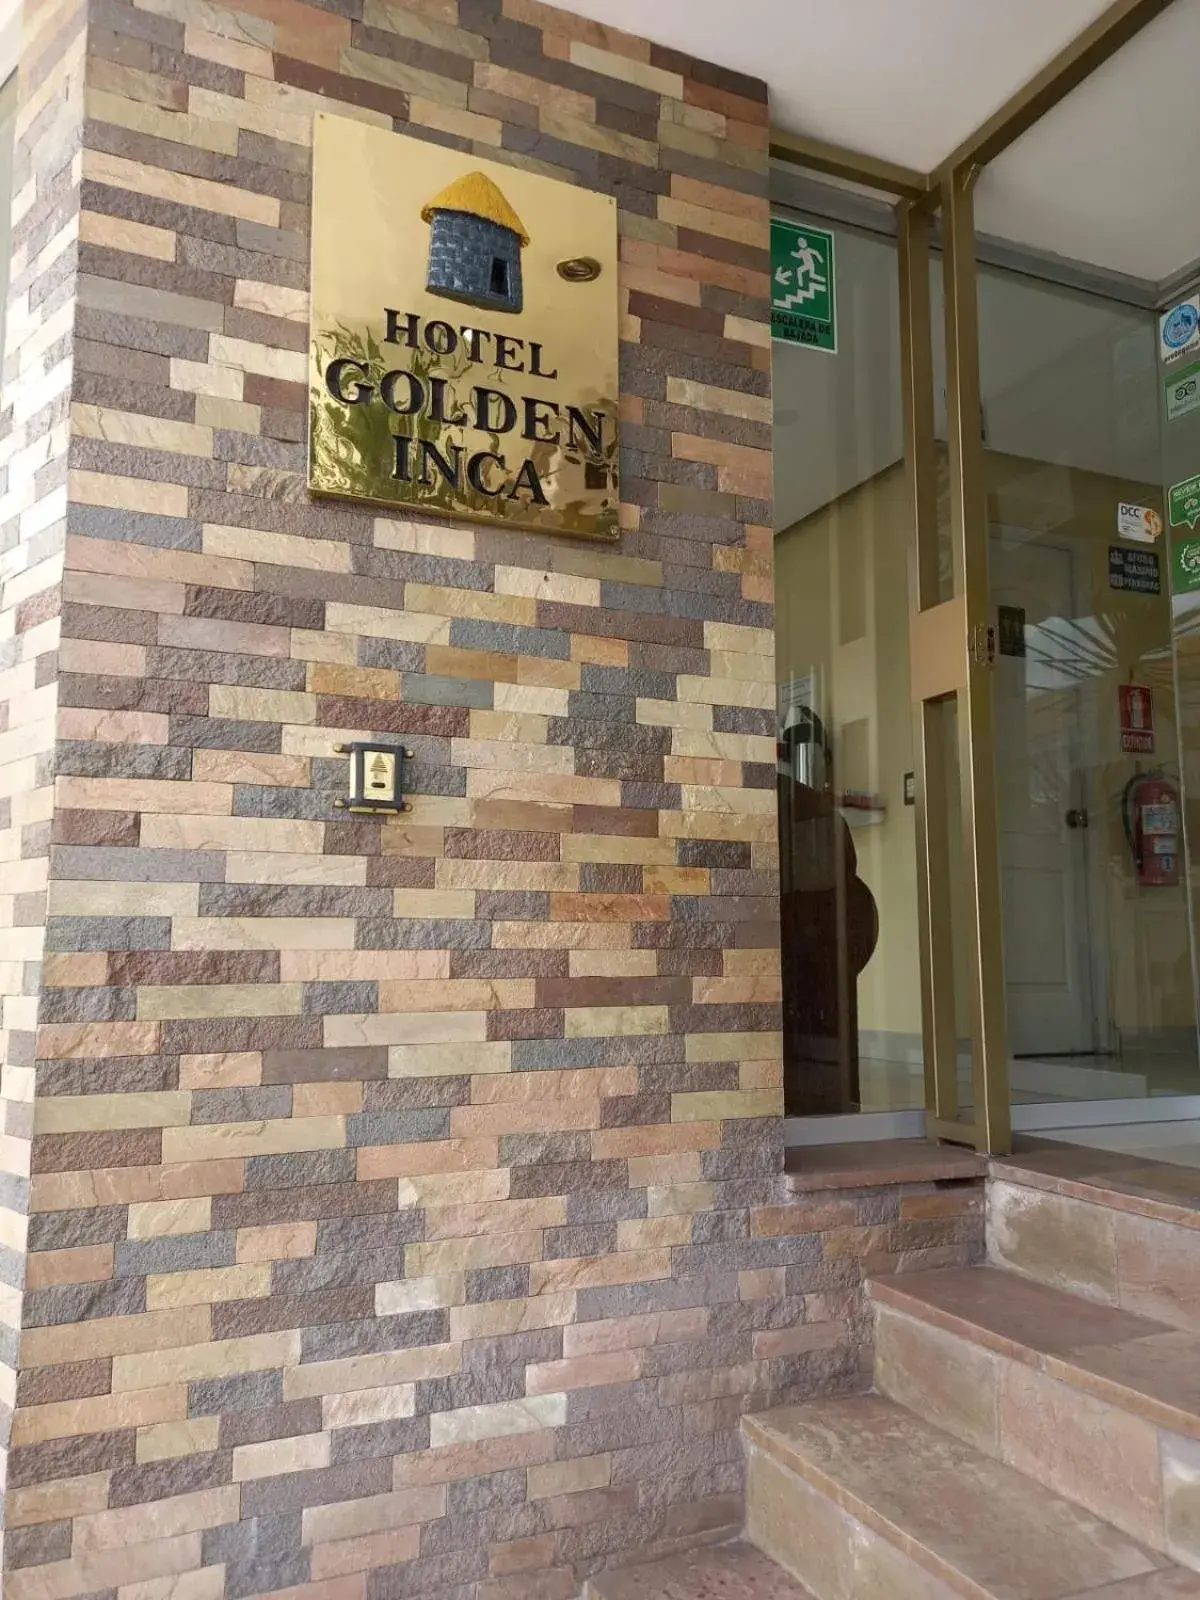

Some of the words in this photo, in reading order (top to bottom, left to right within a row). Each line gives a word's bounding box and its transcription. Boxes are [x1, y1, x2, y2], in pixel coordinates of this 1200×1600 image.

[384, 308, 558, 380] HOTEL
[325, 358, 605, 457] GOLDEN
[391, 434, 550, 505] INCA
[1120, 505, 1140, 518] DCC
